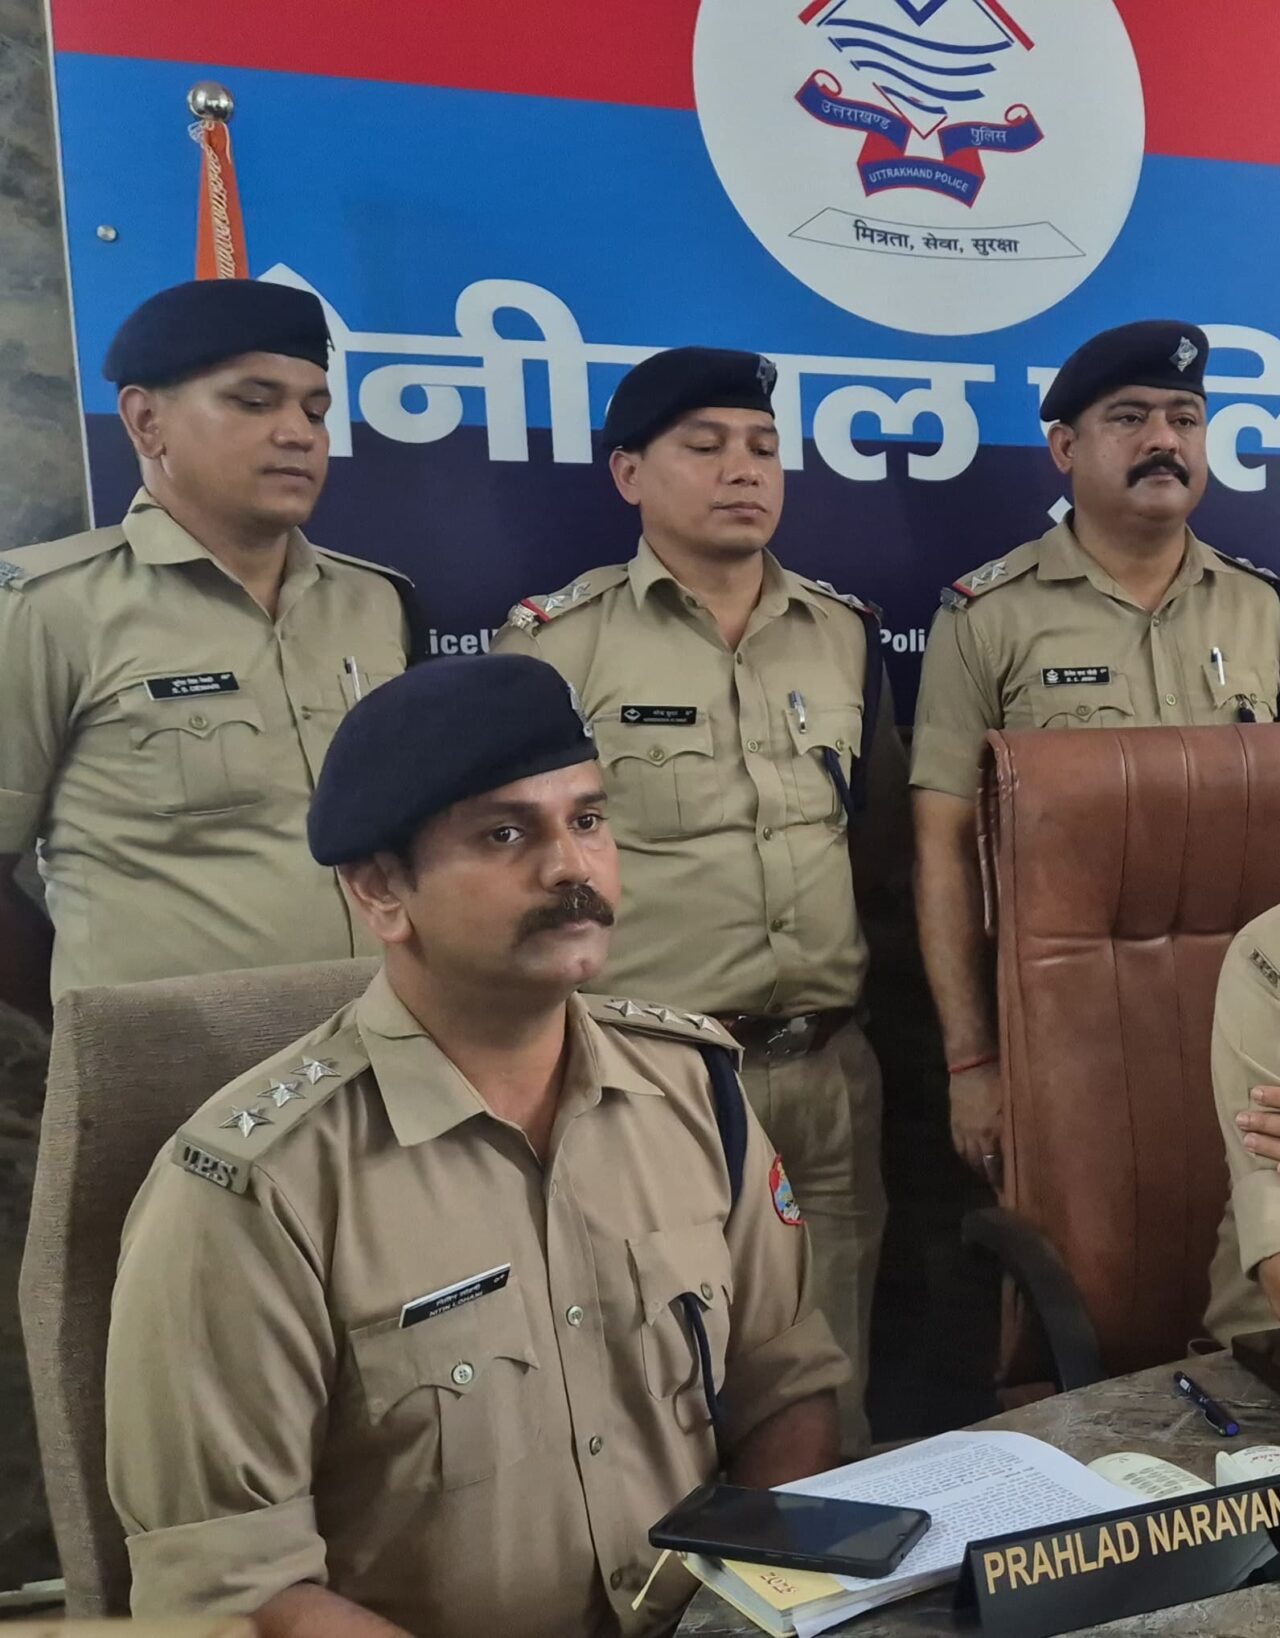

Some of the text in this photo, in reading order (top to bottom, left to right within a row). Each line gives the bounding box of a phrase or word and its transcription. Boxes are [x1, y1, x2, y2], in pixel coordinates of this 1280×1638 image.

[820, 98, 892, 131] उत्तराखण्ड
[970, 126, 1007, 146] पुलिस
[869, 167, 969, 193] UTTRAKHAND POLICE
[853, 219, 1019, 256] मित्रता, सेवा, सुरक्षा
[982, 1521, 1141, 1594] PRAHLAD
